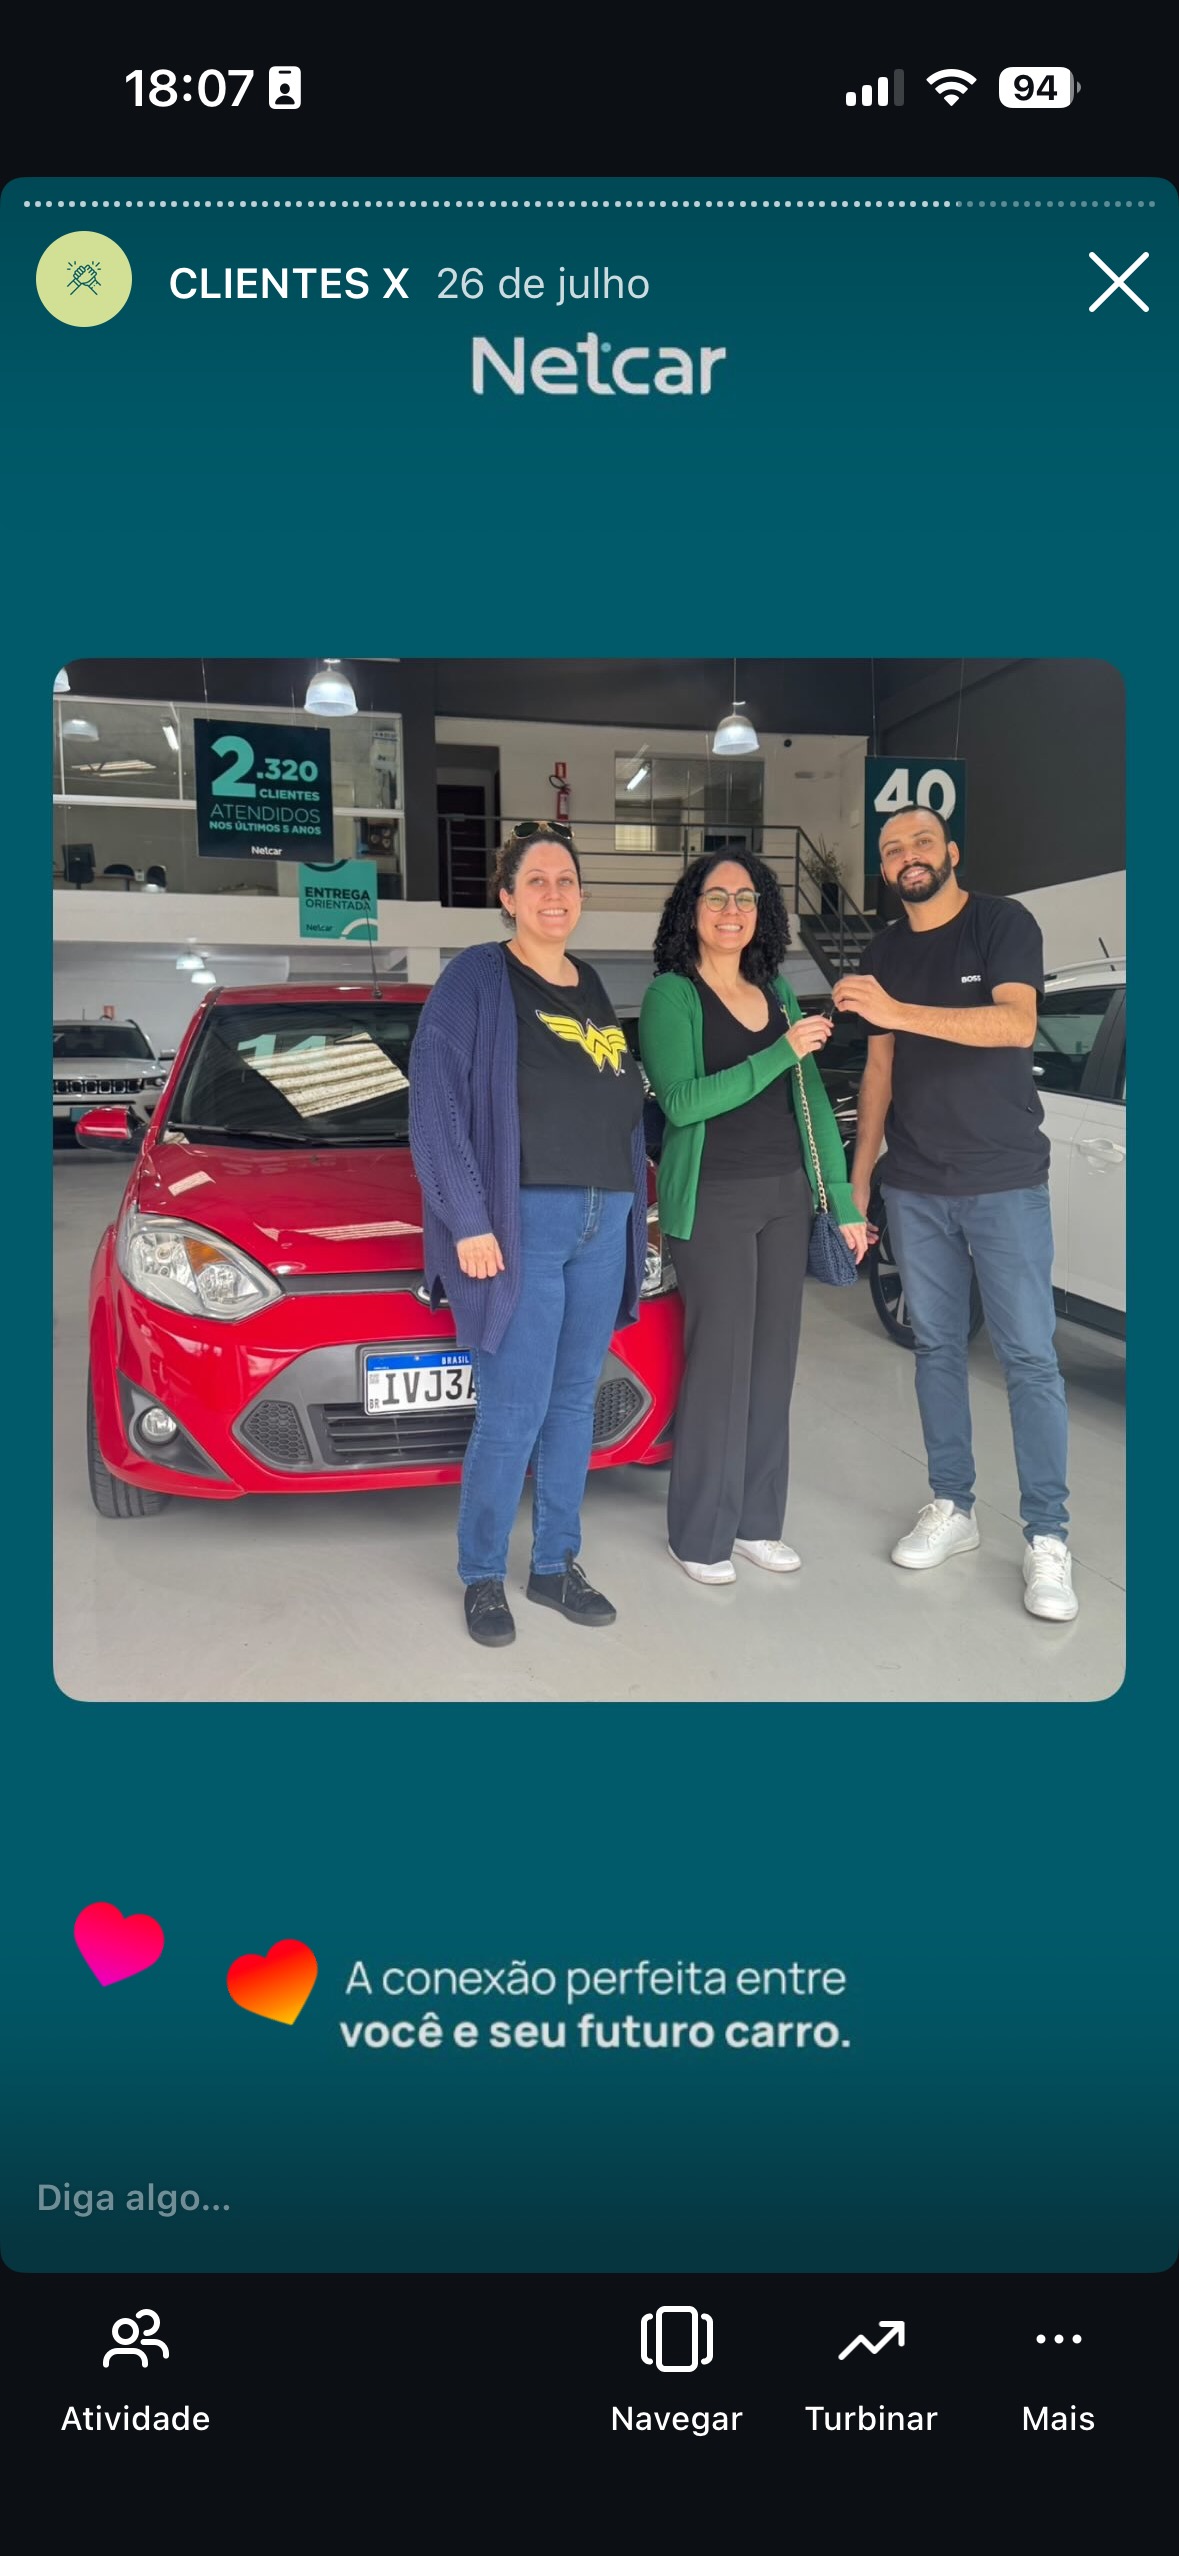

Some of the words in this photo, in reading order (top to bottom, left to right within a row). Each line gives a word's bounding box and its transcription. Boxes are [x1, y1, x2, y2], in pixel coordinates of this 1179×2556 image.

[259, 788, 320, 801] CLIENTES
[874, 768, 956, 821] 40
[210, 803, 320, 823] ATENDIDOS
[209, 821, 232, 830] NOS
[235, 820, 280, 833] ÚLTIMOS
[282, 825, 290, 833] 5
[291, 826, 321, 835] ANOS
[251, 846, 282, 856] Netcar
[305, 886, 371, 902] ENTREGA
[305, 899, 371, 911] ORIENTADA
[961, 975, 981, 983] BOSS
[441, 1356, 470, 1365] BRASIL
[369, 1399, 380, 1409] BR
